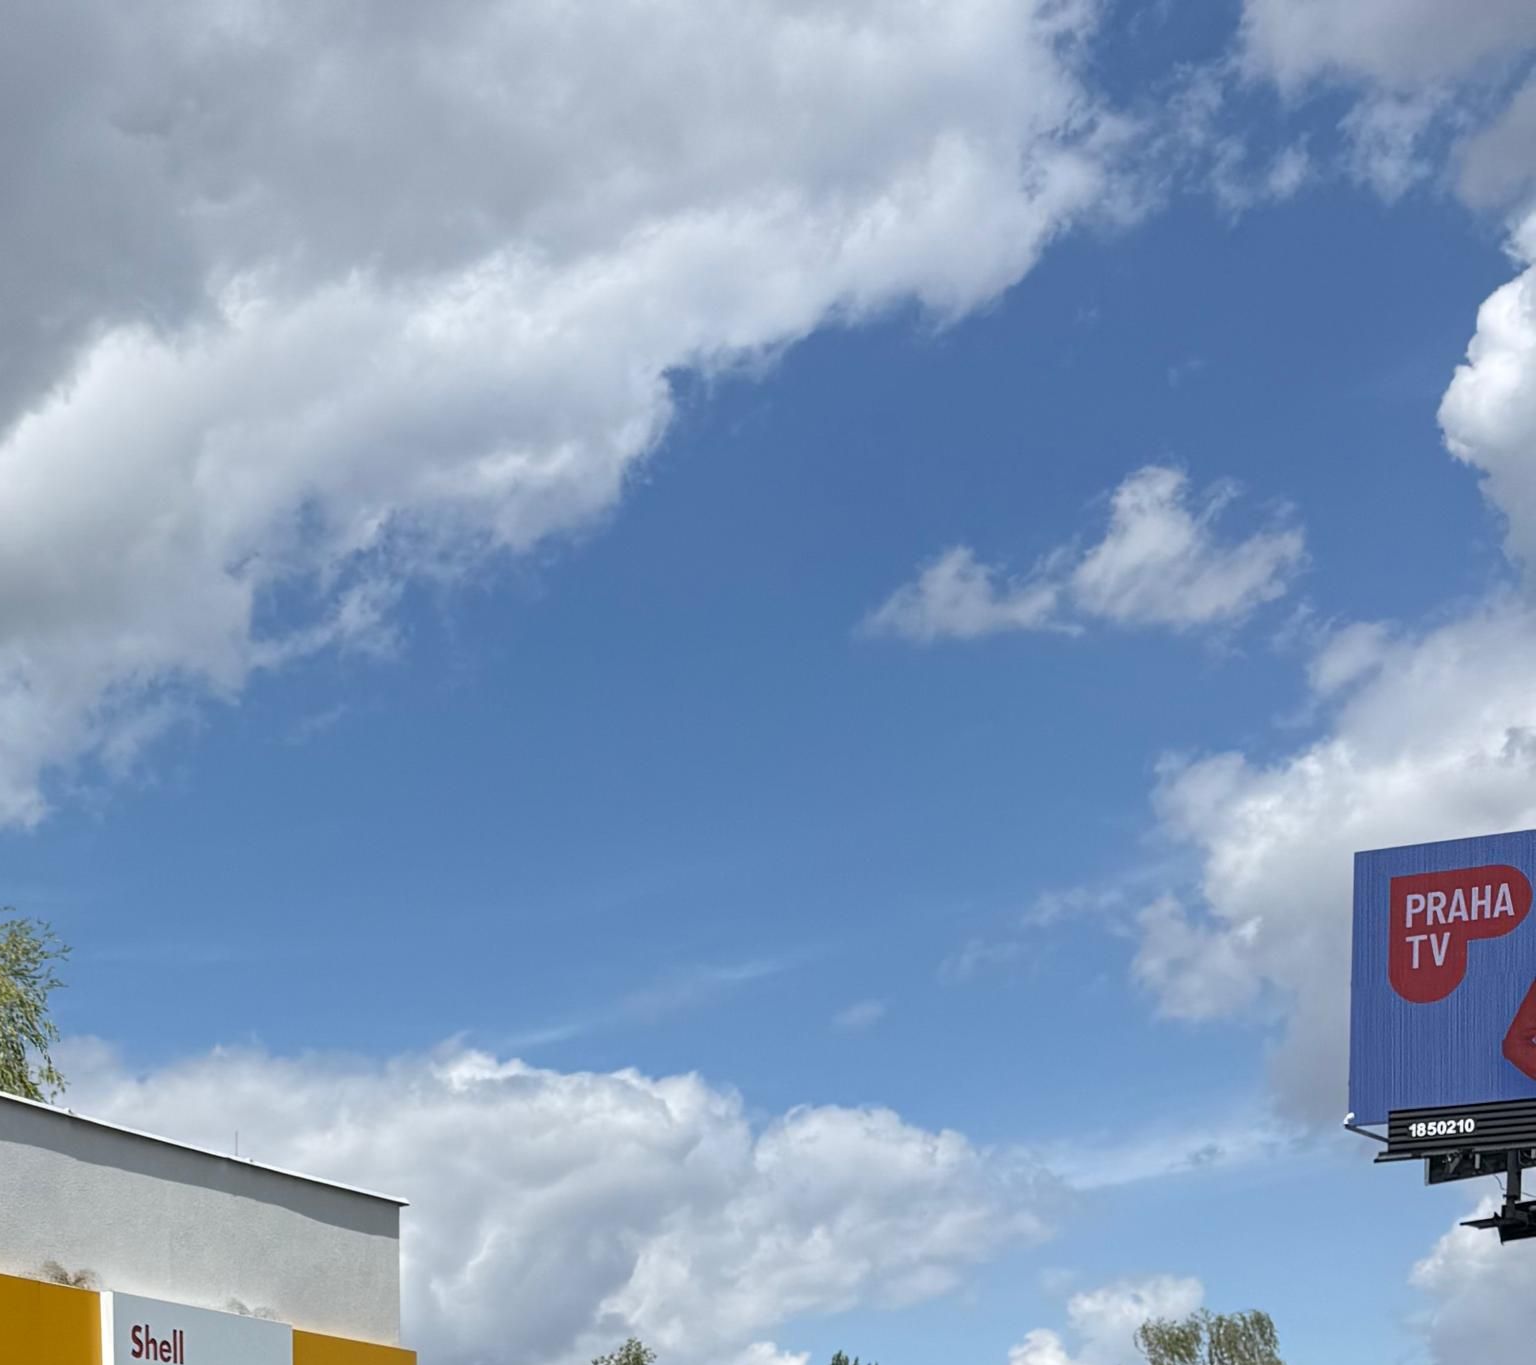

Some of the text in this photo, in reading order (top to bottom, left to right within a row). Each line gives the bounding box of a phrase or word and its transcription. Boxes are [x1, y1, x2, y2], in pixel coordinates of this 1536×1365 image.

[1406, 883, 1515, 928] PRAHA
[1406, 932, 1450, 969] TV
[1408, 1118, 1475, 1137] 1850210
[131, 1324, 184, 1365] Shell
